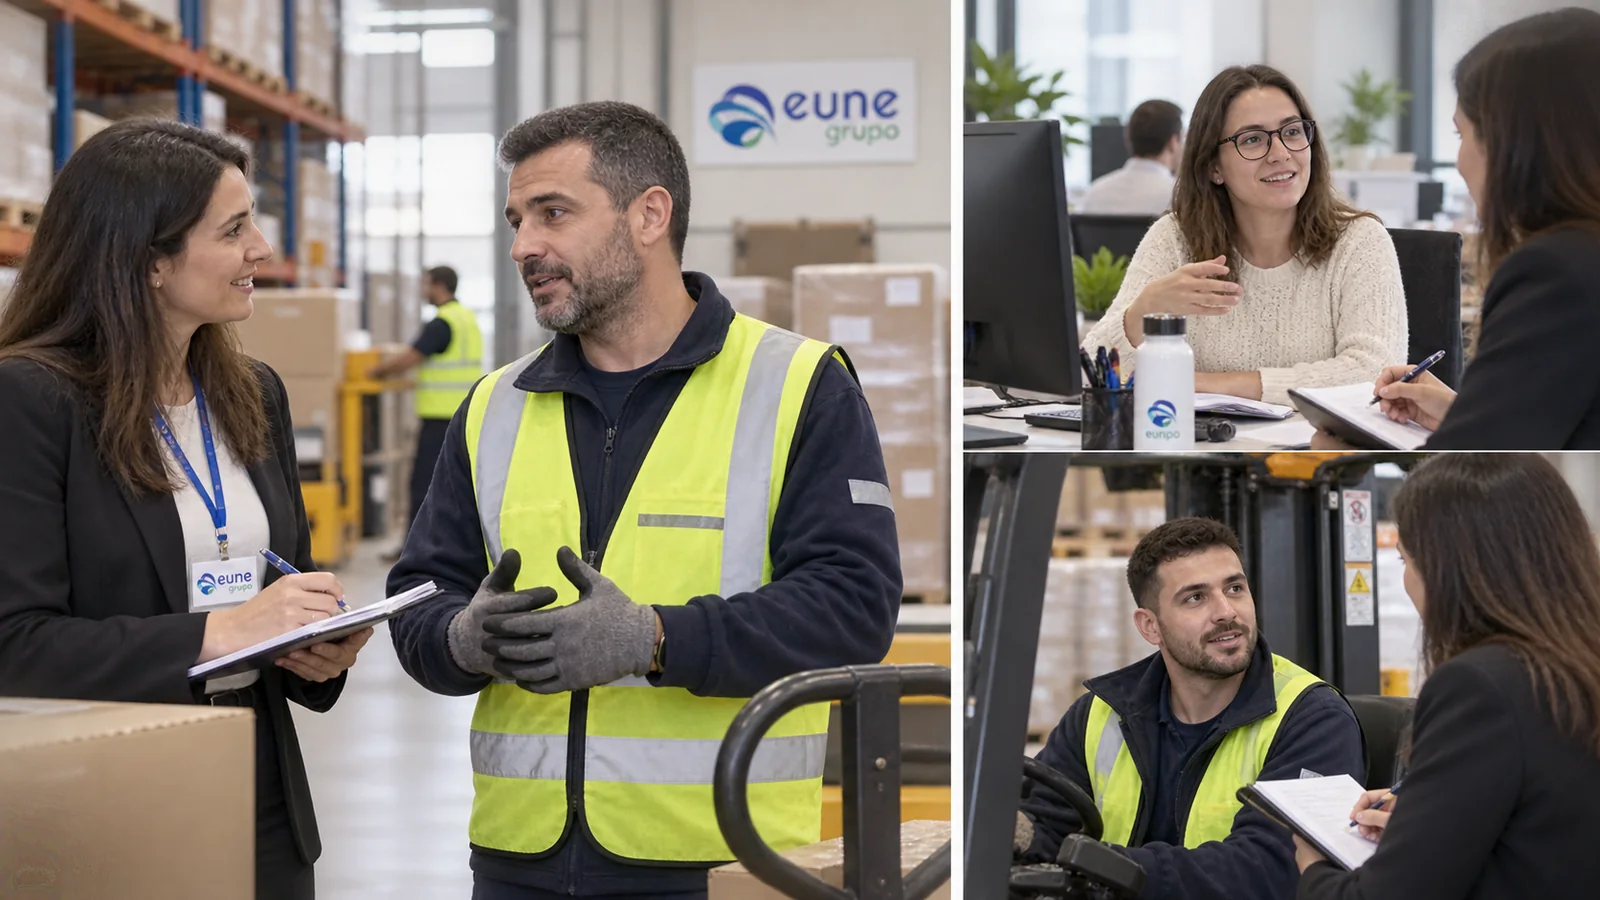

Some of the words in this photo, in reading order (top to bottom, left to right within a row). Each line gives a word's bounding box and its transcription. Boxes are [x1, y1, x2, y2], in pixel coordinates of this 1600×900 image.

[783, 89, 898, 120] eune
[825, 124, 900, 147] grupo
[217, 572, 252, 585] eune
[228, 584, 253, 594] grupo
